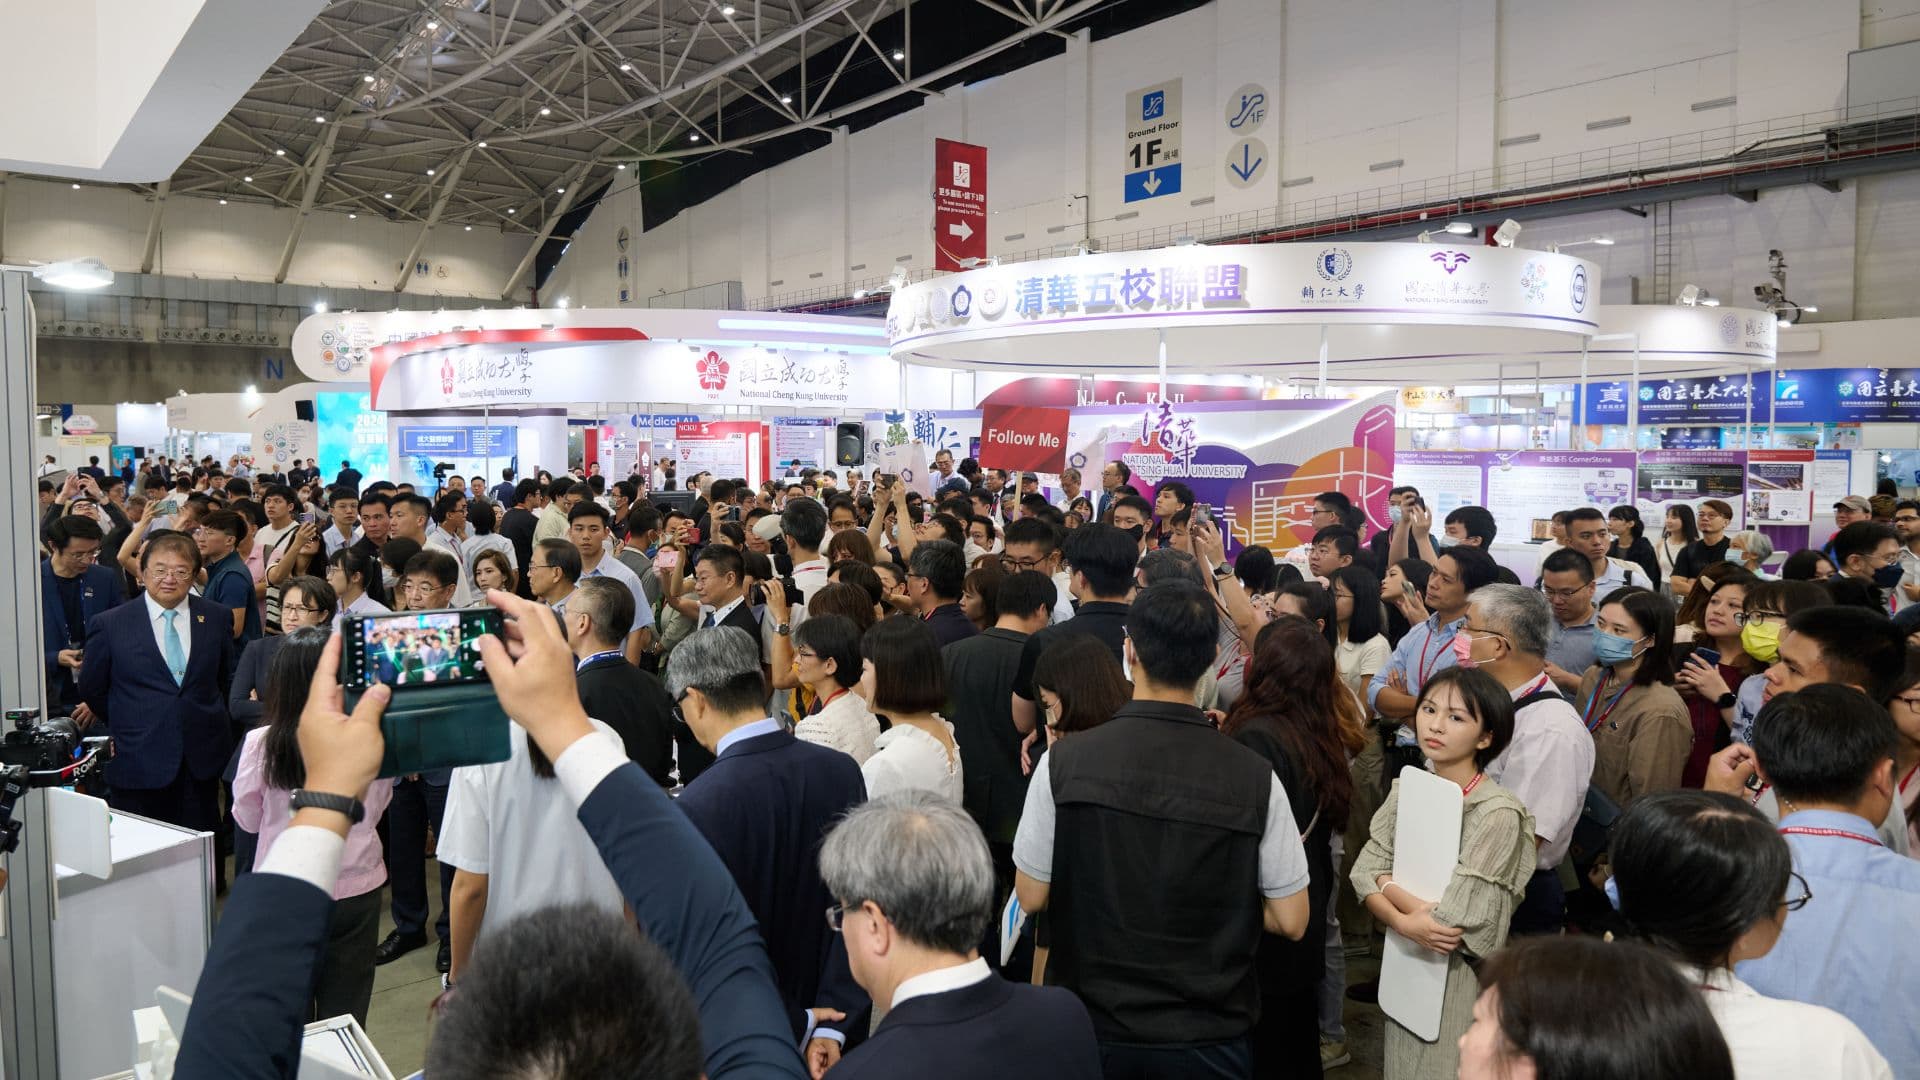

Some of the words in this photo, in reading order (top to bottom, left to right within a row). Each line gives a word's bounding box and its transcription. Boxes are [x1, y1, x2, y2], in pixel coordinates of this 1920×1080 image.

[1250, 109, 1265, 124] 1F
[1128, 126, 1156, 139] Ground
[1158, 121, 1180, 132] Floor
[1129, 138, 1162, 168] 1F
[1015, 264, 1242, 314] 清華五校聯盟
[1301, 283, 1366, 301] 輔仁大學
[266, 359, 283, 380] N
[495, 386, 533, 398] University
[740, 389, 771, 398] National
[772, 390, 794, 400] Cheng
[795, 391, 813, 401] Kung
[814, 392, 848, 402] University
[679, 424, 697, 432] NCKU
[988, 428, 1035, 446] Follow
[1038, 432, 1060, 448] Me
[1124, 455, 1167, 465] NATIONAL
[1568, 455, 1613, 463] CornerStone
[1136, 465, 1162, 475] TSING
[1164, 464, 1182, 475] HUA
[1192, 465, 1246, 476] UNIVERSITY
